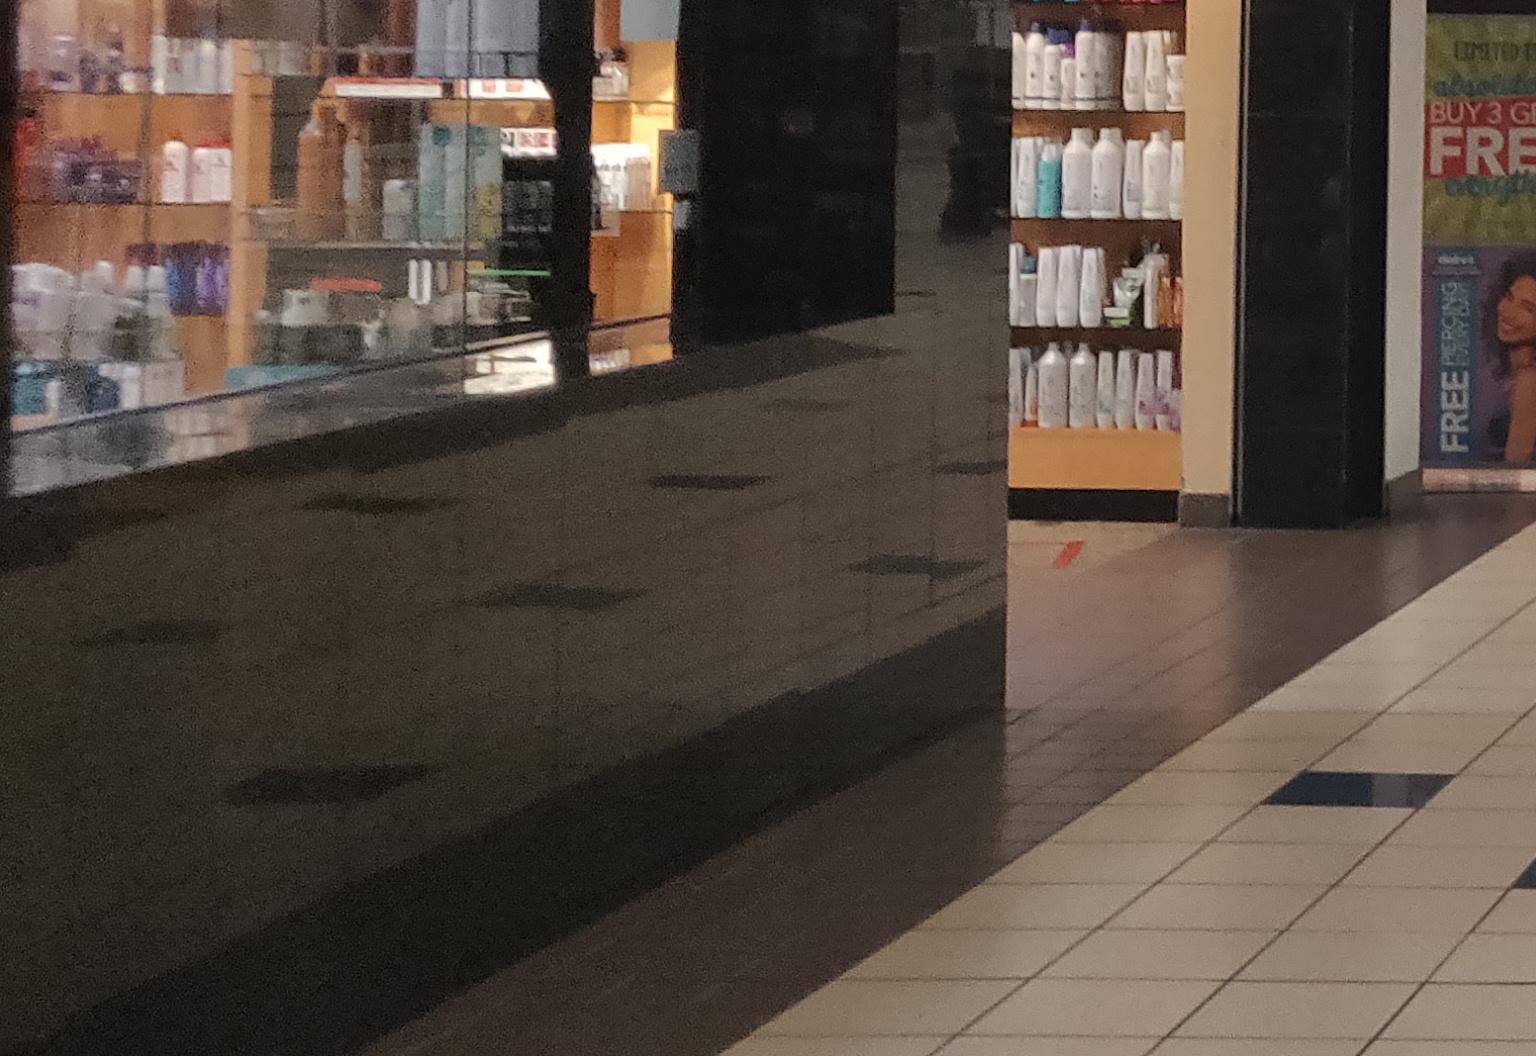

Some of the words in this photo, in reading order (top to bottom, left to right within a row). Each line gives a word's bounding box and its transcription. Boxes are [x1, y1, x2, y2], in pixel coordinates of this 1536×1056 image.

[1429, 101, 1482, 124] BUY
[1487, 102, 1502, 124] 3
[1441, 282, 1458, 366] PIERCING
[1440, 371, 1470, 453] FREE
